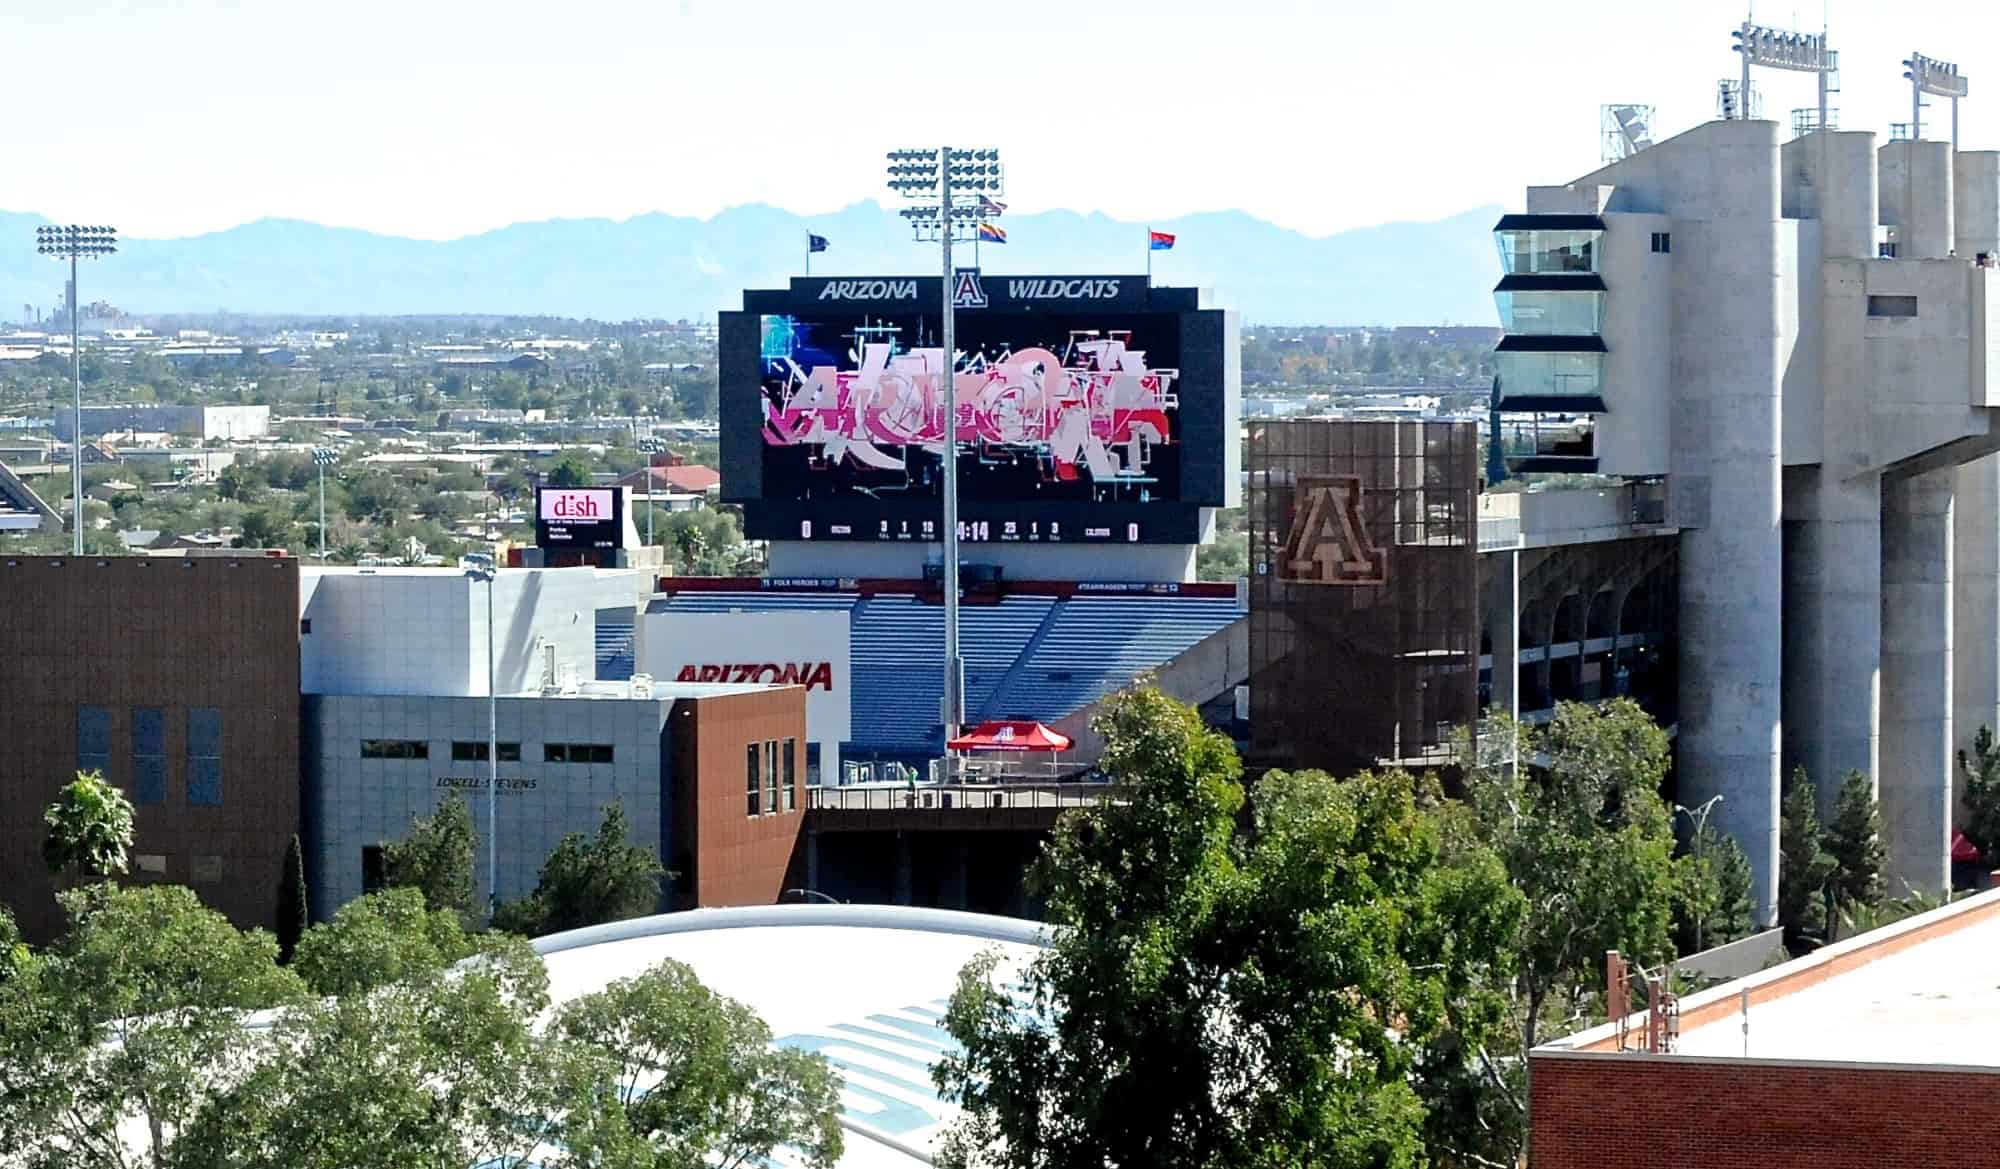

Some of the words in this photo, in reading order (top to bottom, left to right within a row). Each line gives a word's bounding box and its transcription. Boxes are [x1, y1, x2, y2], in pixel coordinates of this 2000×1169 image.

[819, 280, 917, 299] ARIZONA
[951, 267, 988, 308] A
[1008, 279, 1120, 299] WILDCATS
[554, 495, 598, 517] dish
[1274, 473, 1388, 585] A
[676, 661, 833, 692] ARIZONA
[436, 777, 537, 790] LOWELL-SEVENS
